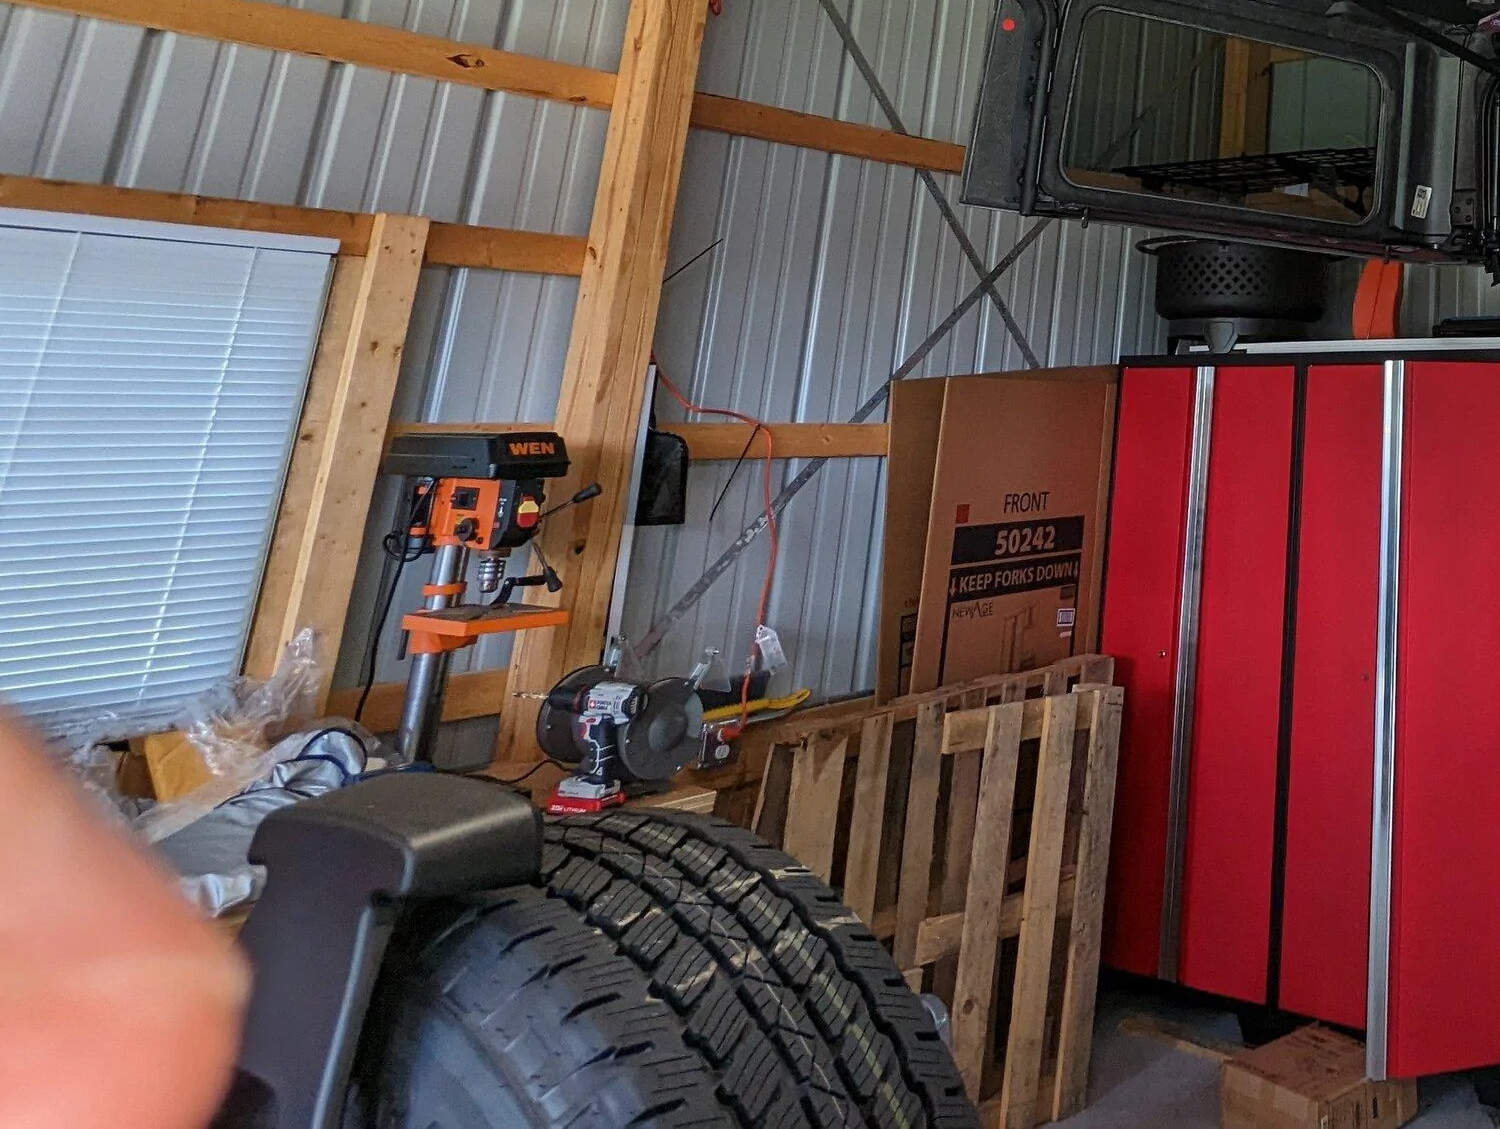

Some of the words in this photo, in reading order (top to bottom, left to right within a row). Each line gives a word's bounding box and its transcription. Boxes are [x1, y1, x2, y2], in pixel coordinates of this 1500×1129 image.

[508, 441, 555, 456] WEN
[1003, 491, 1050, 514] FRONT
[994, 525, 1056, 556] 50242
[959, 572, 993, 593] KEEP
[994, 566, 1035, 588] FORKS
[1036, 561, 1074, 582] DOWN
